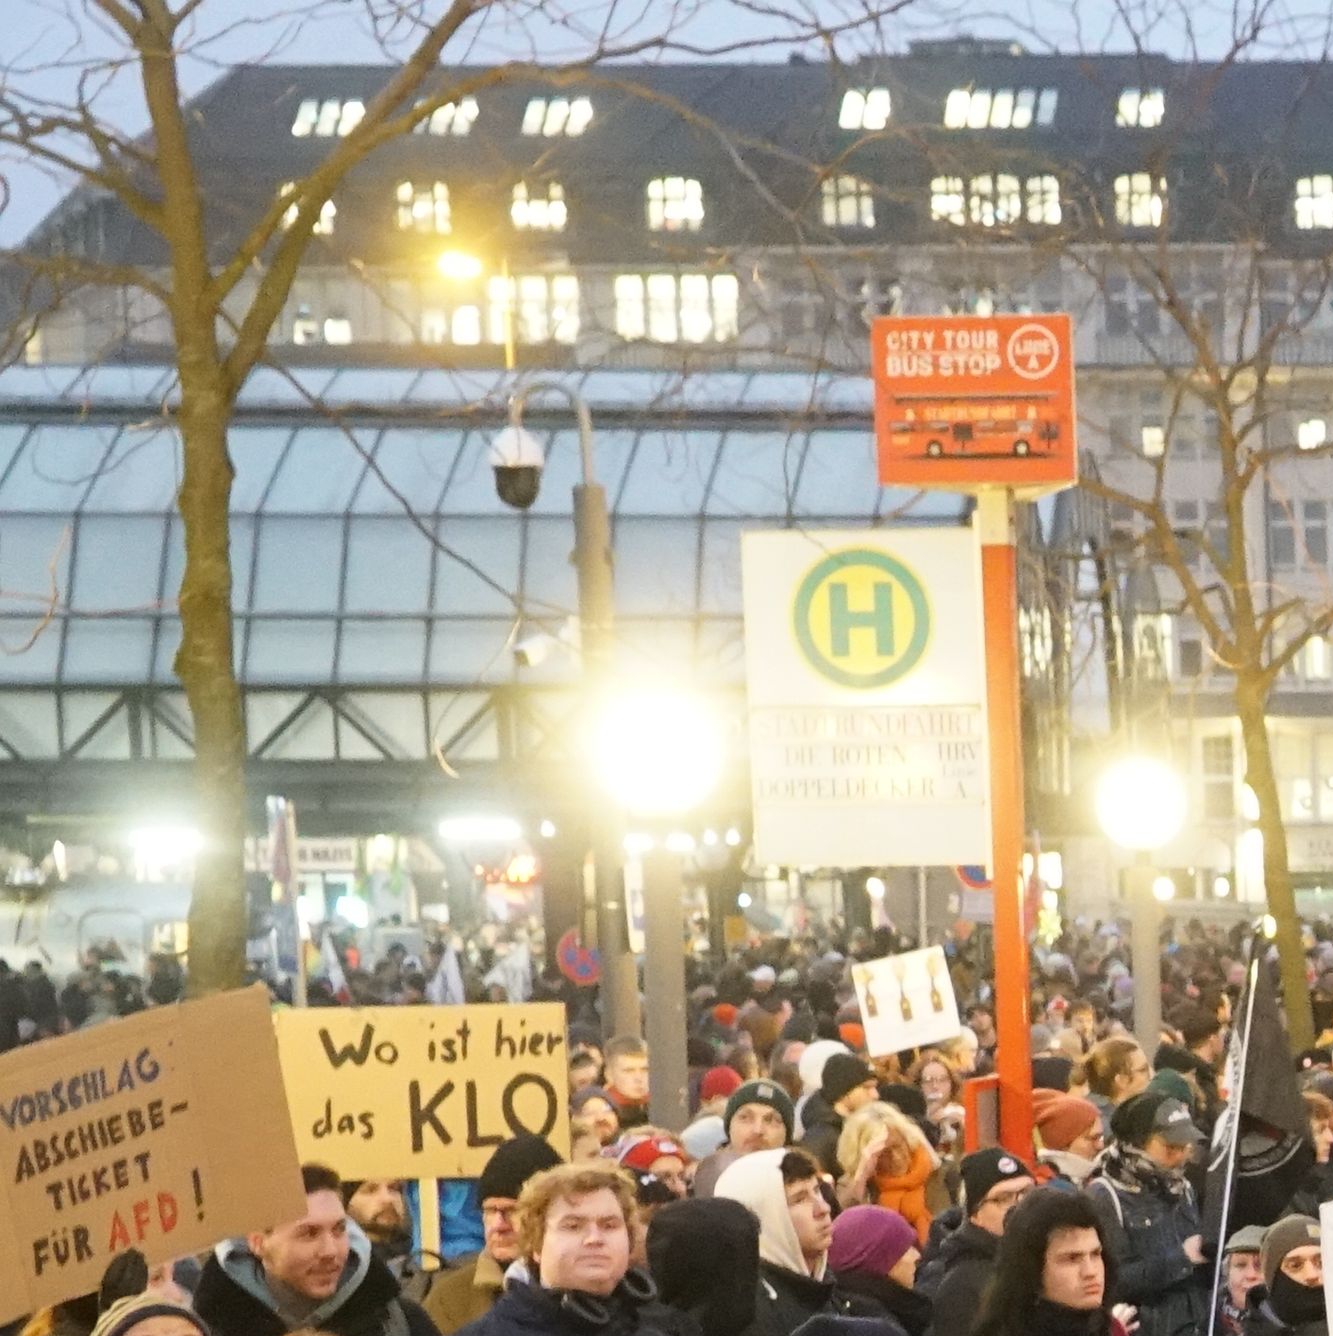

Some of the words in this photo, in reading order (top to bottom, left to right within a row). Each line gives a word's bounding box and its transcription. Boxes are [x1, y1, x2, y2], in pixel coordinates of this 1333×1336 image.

[886, 329, 935, 351] CITY
[942, 328, 999, 351] TOUR
[886, 353, 934, 378] BUS
[938, 353, 1002, 378] STOP
[828, 581, 896, 658] H
[319, 1022, 399, 1069] Wo
[428, 1018, 471, 1064] ist
[495, 1017, 563, 1060] hier
[312, 1096, 375, 1140] das
[408, 1072, 558, 1154] KLO
[46, 1151, 152, 1212] TICKET
[33, 1224, 95, 1277] FÜR
